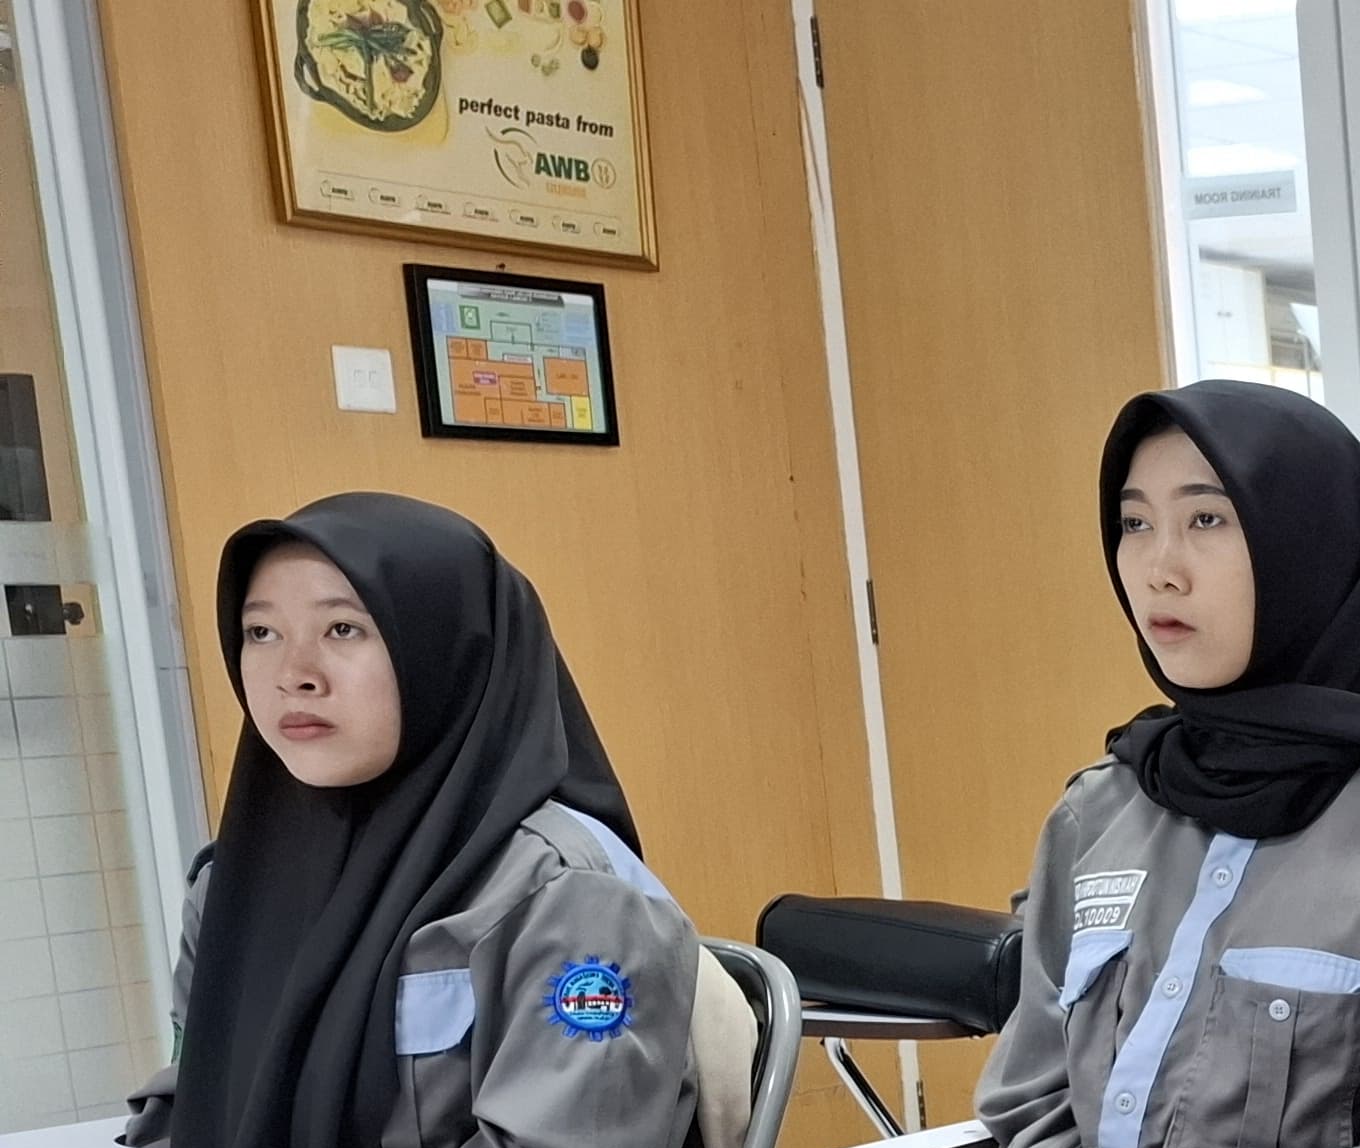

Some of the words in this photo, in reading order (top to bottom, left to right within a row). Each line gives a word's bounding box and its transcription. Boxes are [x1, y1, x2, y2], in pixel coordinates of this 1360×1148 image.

[458, 97, 521, 121] perfect
[525, 109, 571, 130] pasta
[576, 115, 614, 138] from
[534, 152, 591, 183] AWB
